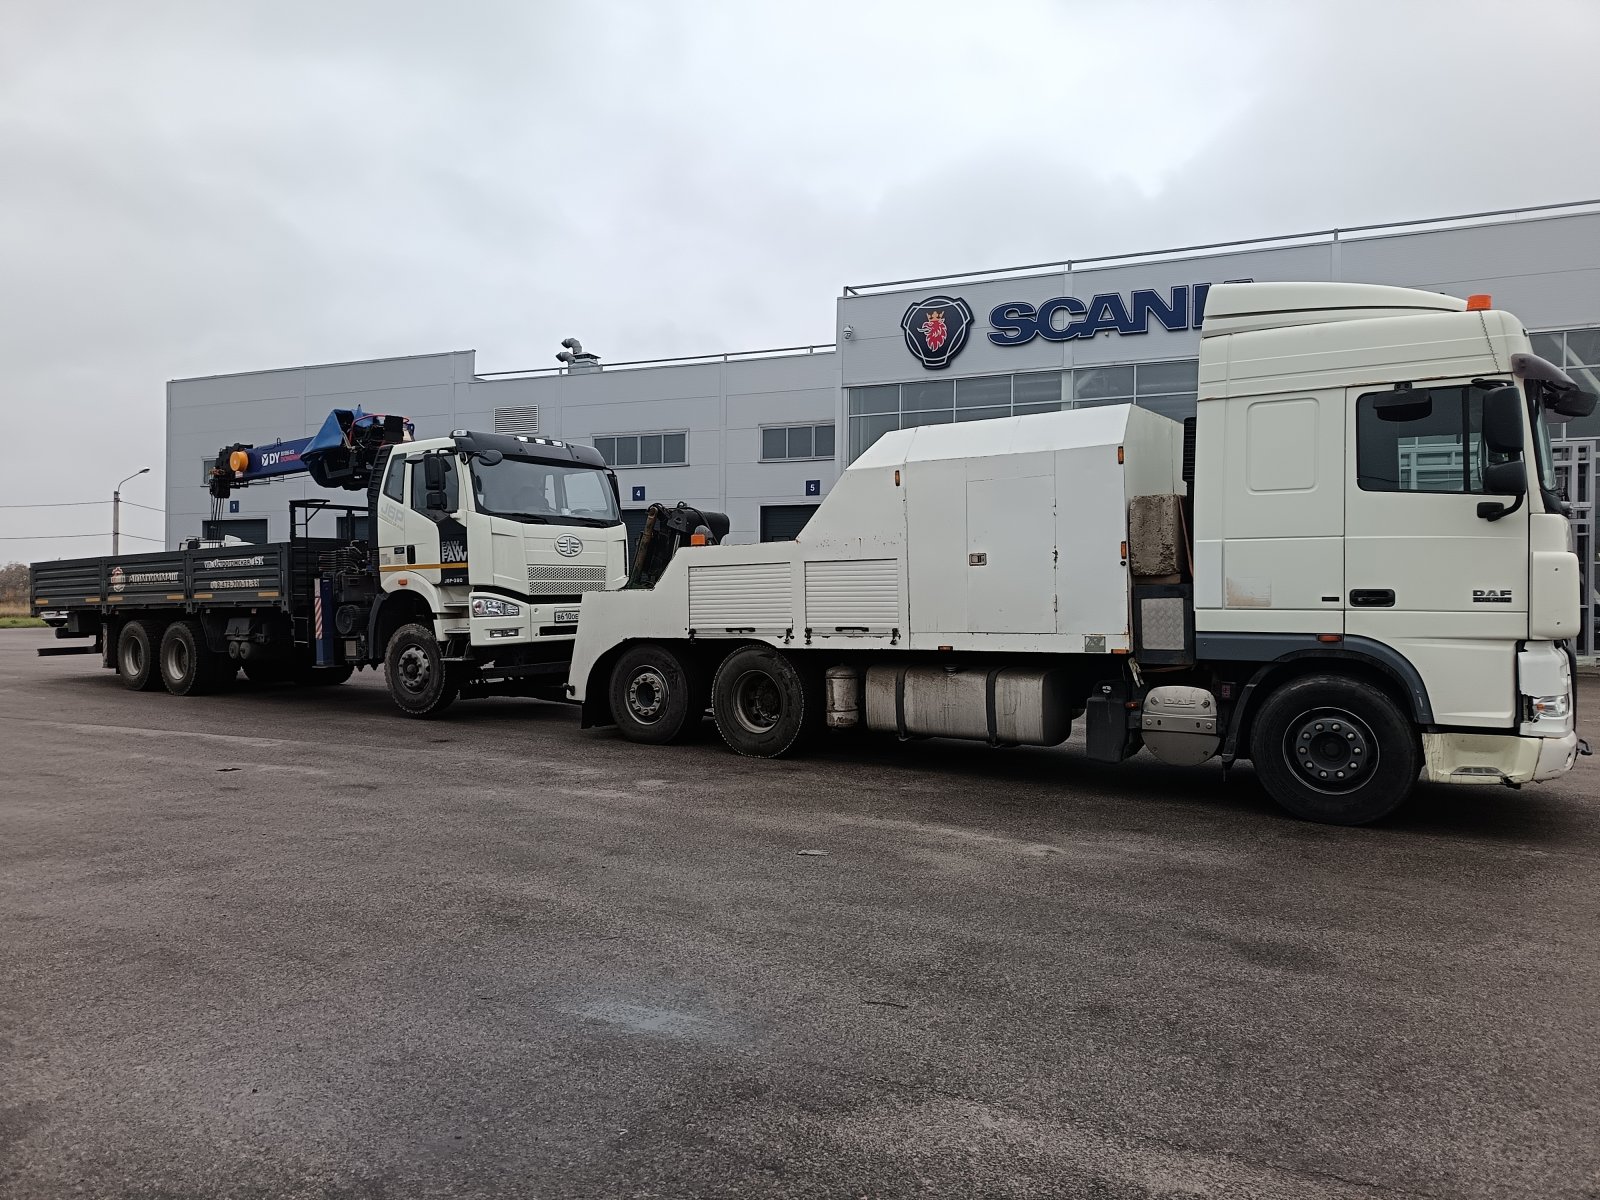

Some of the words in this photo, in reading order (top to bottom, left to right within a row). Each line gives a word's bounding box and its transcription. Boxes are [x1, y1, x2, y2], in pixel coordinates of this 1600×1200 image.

[982, 279, 1253, 346] SCANI
[269, 452, 280, 465] DY
[441, 551, 468, 563] FAW
